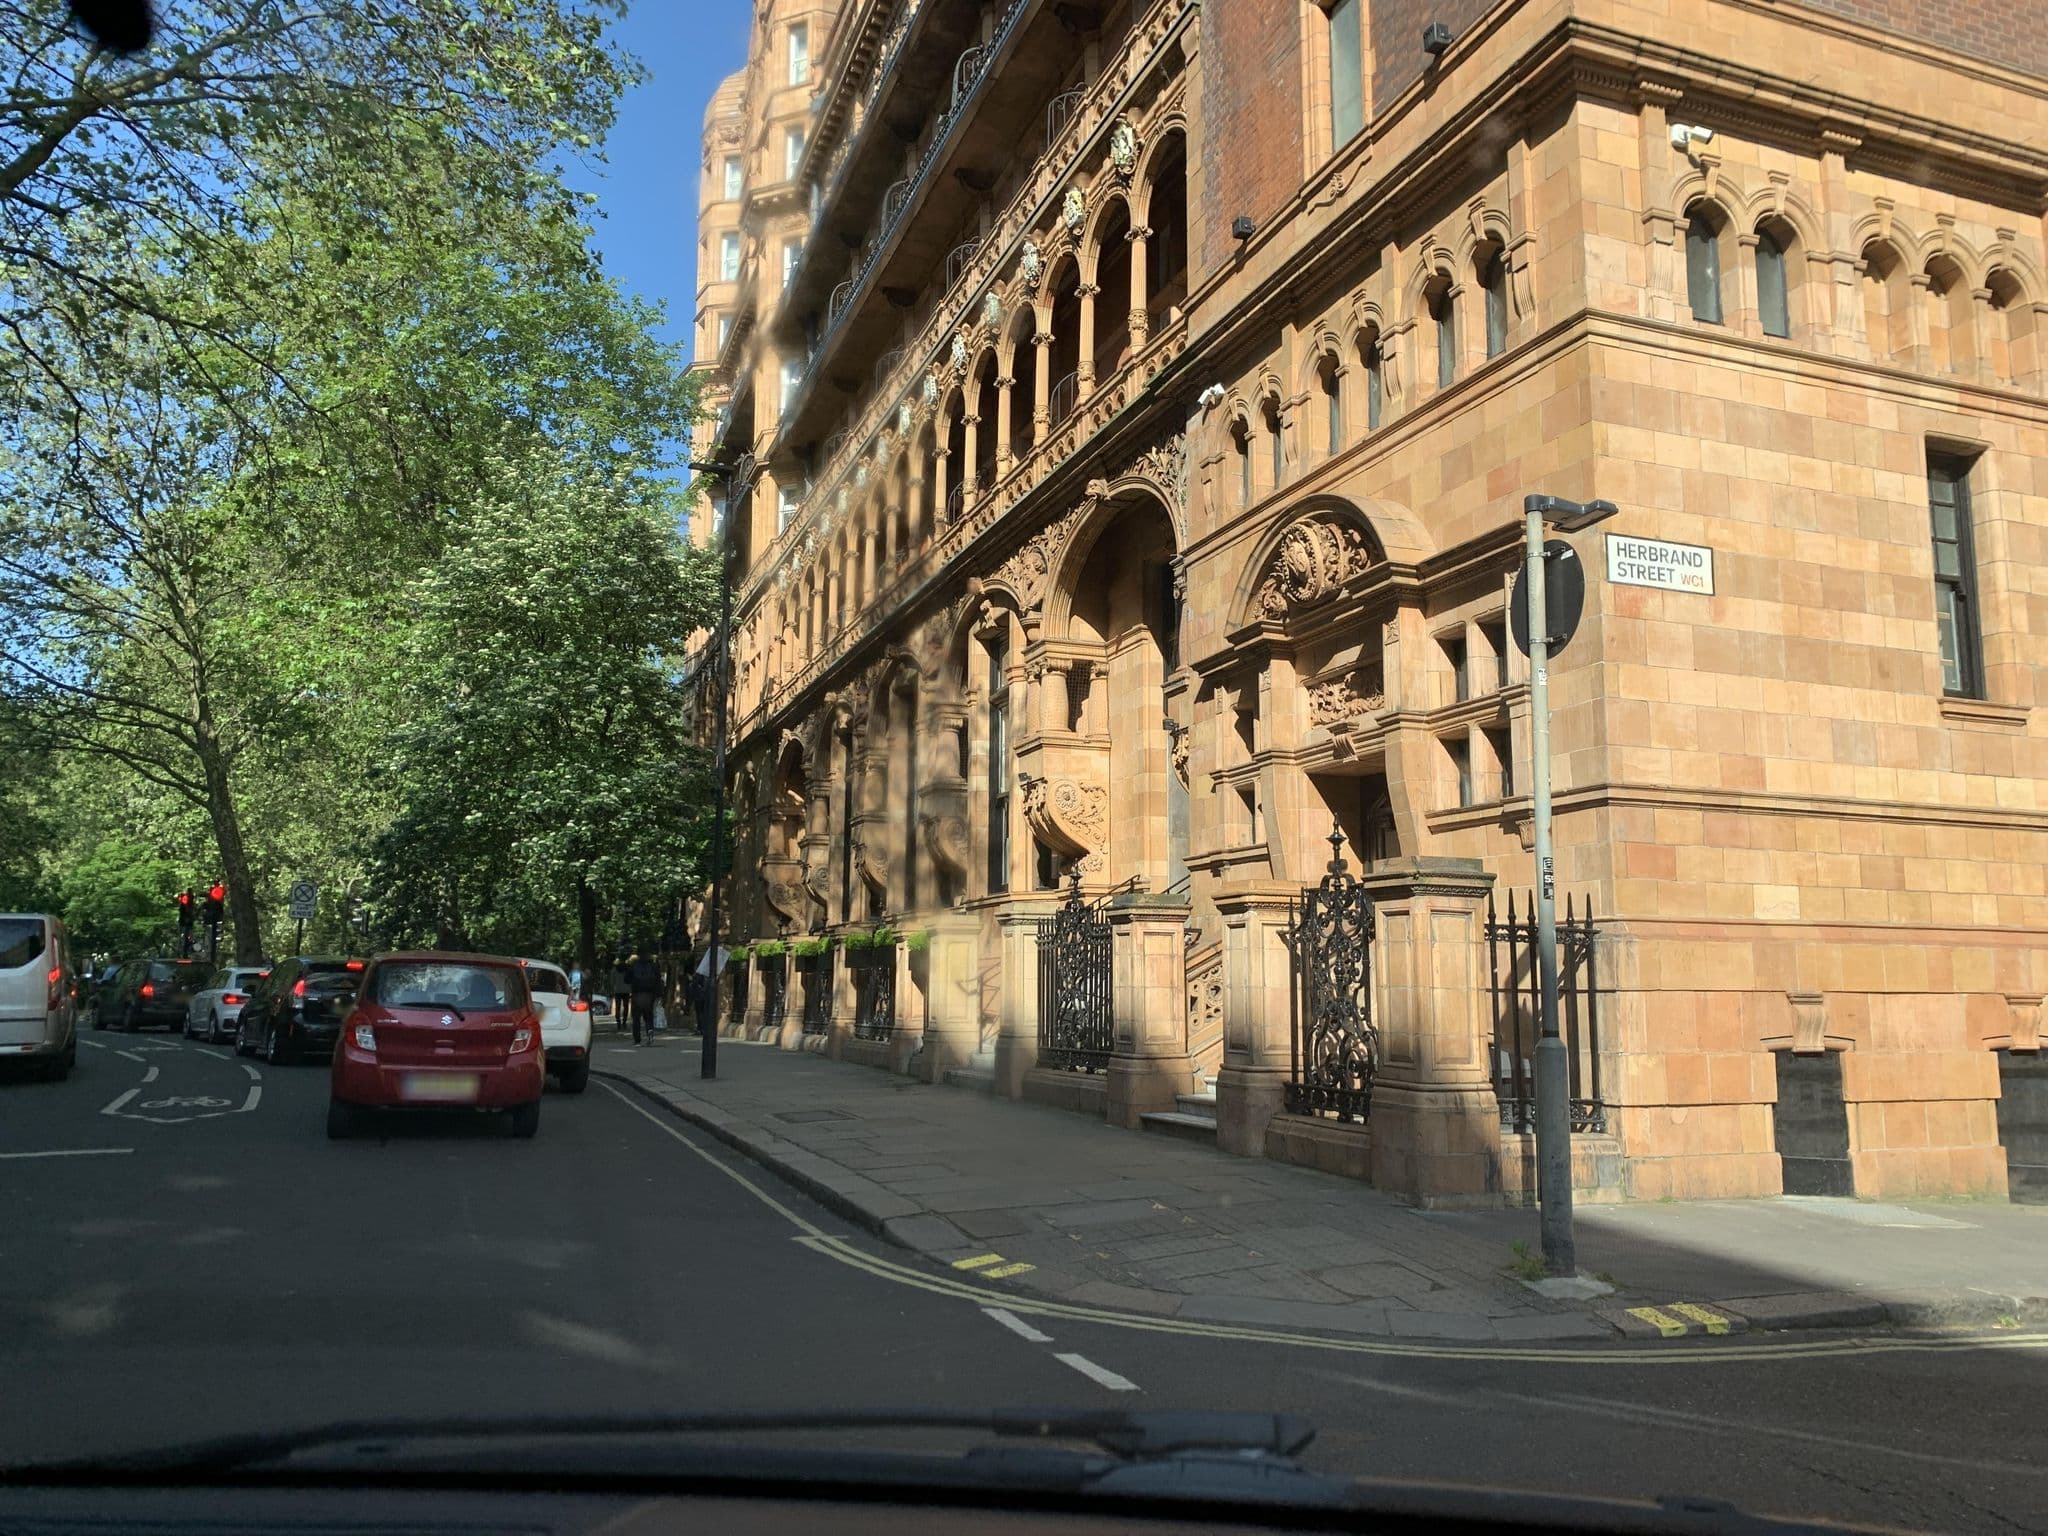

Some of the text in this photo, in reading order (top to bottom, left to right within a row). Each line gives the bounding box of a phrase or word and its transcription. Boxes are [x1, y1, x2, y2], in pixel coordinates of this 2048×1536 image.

[1617, 541, 1703, 568] HERBRAND
[1617, 561, 1704, 588] STREET WC1
